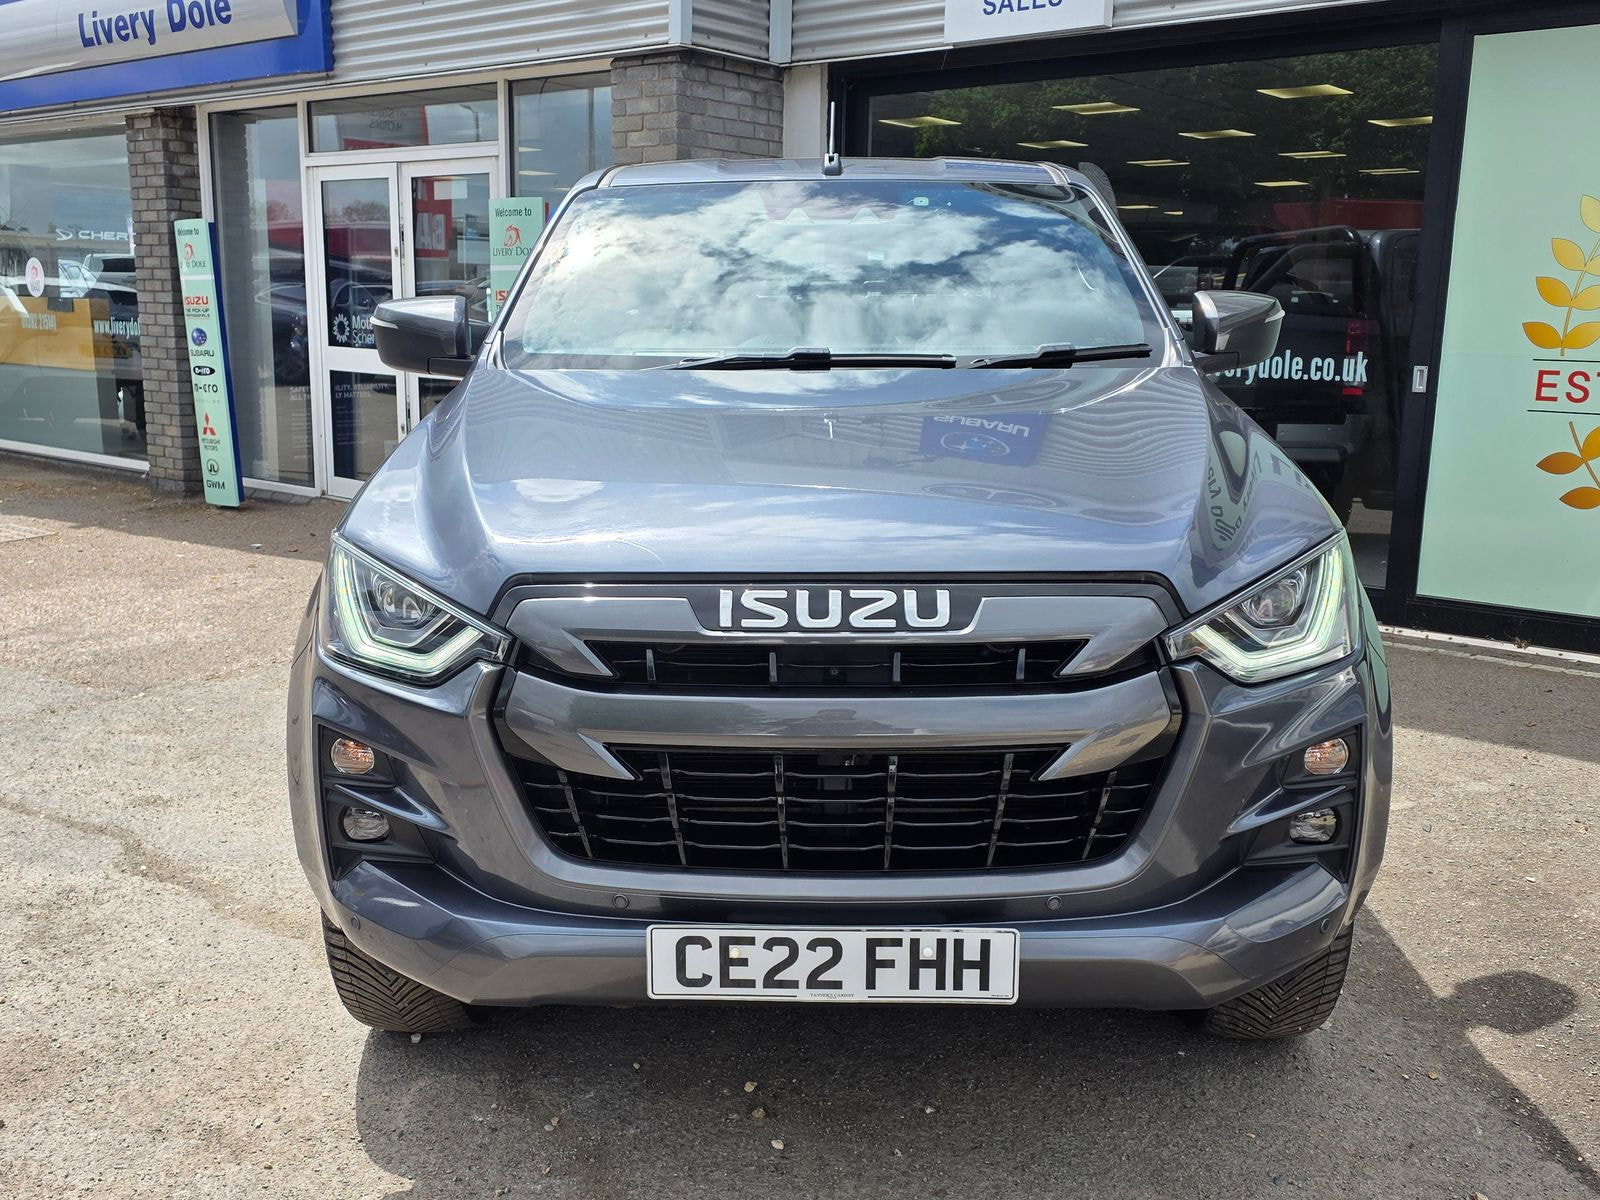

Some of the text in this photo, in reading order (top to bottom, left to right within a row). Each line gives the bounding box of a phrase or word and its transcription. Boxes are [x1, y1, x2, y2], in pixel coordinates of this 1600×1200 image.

[78, 0, 232, 46] Livery Dole
[495, 207, 532, 217] Welcome to
[78, 230, 129, 241] CHER
[493, 246, 513, 257] LIVERY
[495, 290, 509, 302] IS
[1535, 369, 1600, 404] ES
[206, 479, 226, 490] GWM
[719, 589, 950, 628] ISUZU
[675, 935, 991, 991] CE22 FHH
